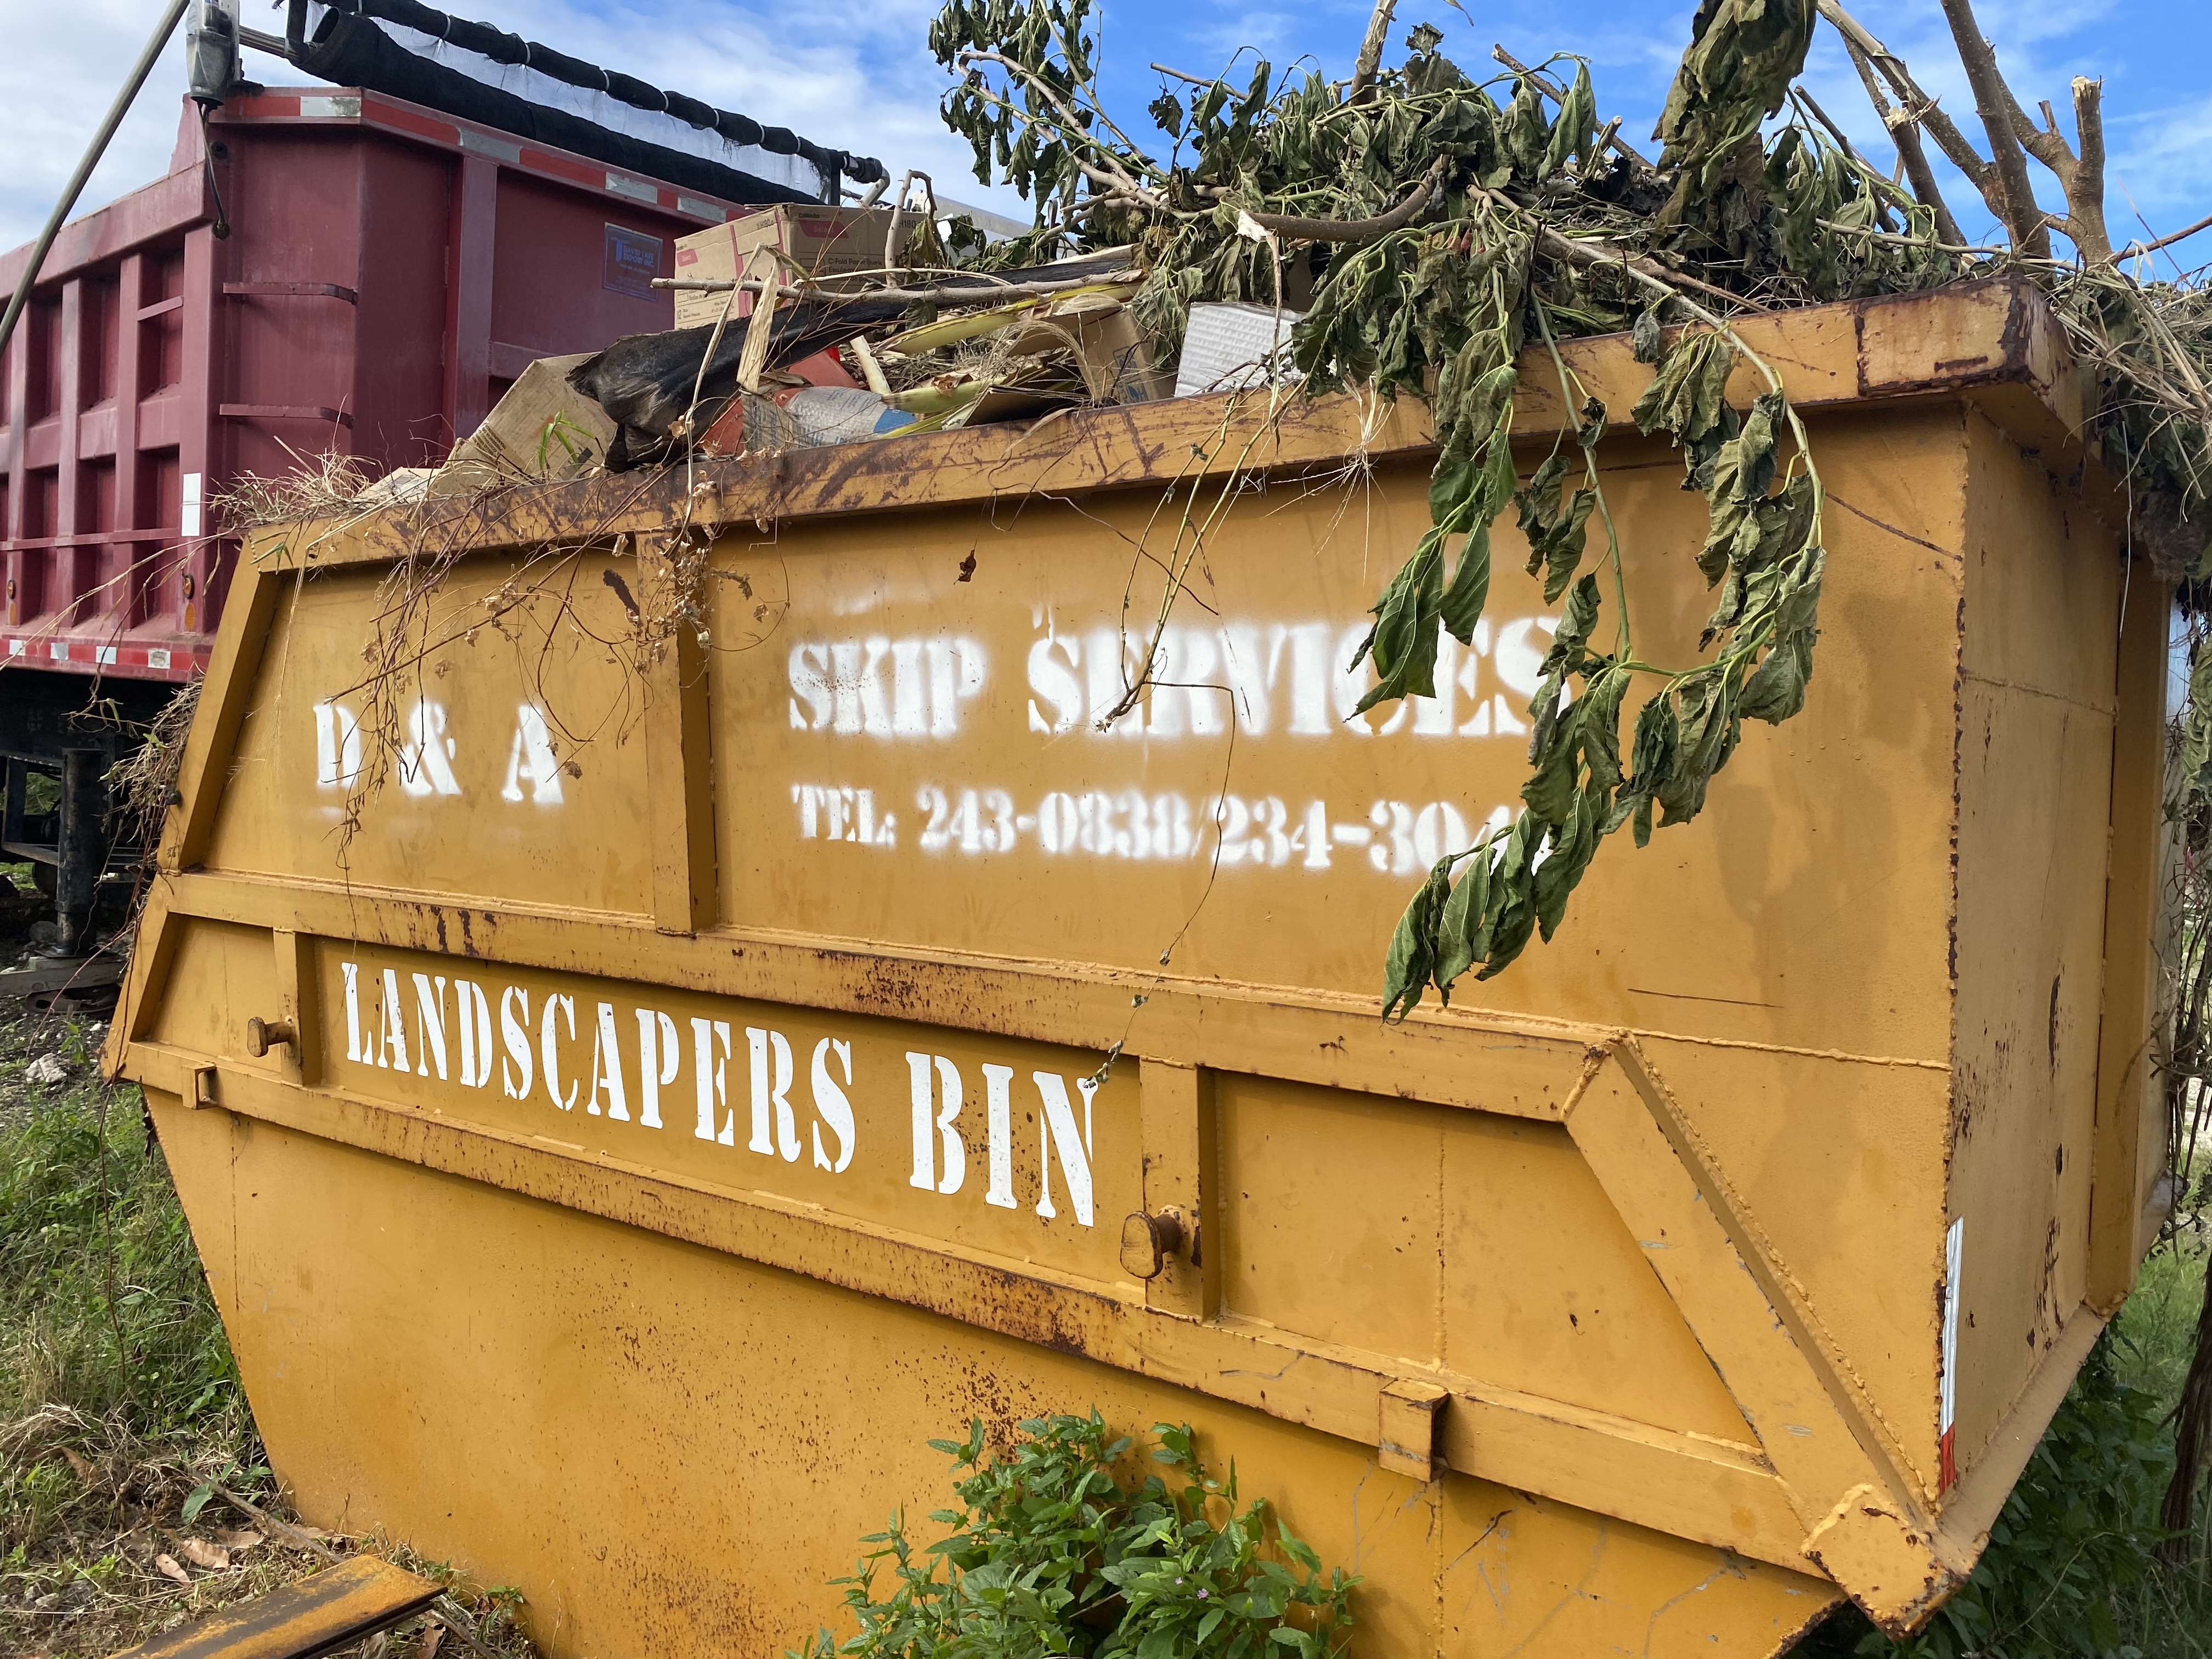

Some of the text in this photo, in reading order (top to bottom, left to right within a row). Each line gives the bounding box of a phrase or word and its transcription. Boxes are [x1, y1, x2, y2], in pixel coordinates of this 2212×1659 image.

[849, 258, 866, 266] Paper
[788, 616, 1572, 738] SKIP SERVICES
[313, 701, 564, 804] D & A
[341, 962, 1099, 1228] LANDSCAPERS BIN
